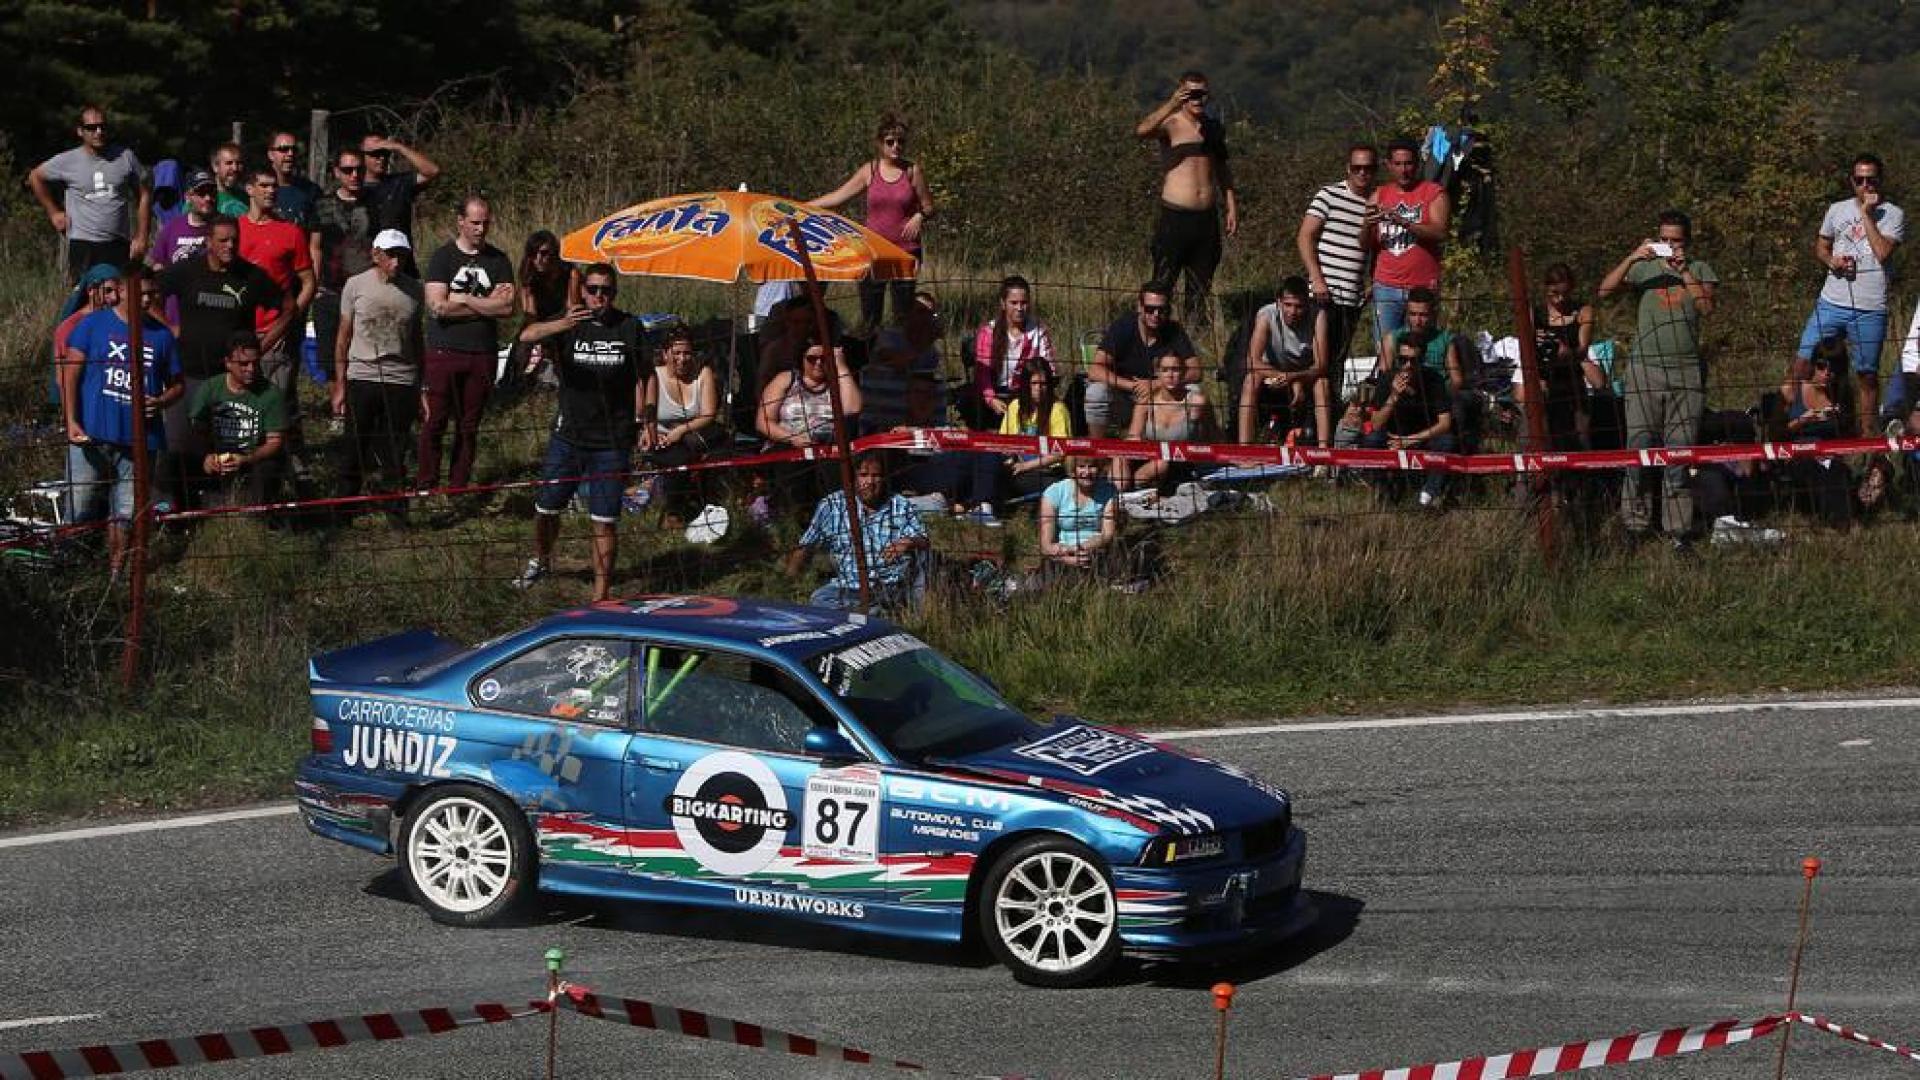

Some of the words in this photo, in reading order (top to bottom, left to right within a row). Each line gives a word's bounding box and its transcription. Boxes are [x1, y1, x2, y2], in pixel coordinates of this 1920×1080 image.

[594, 203, 731, 249] Fanta
[339, 697, 456, 732] CARROCERIAS
[342, 724, 458, 777] JUNDIZ
[672, 797, 787, 829] BIGKARTING
[816, 798, 869, 846] 87
[972, 817, 1004, 831] CLUB
